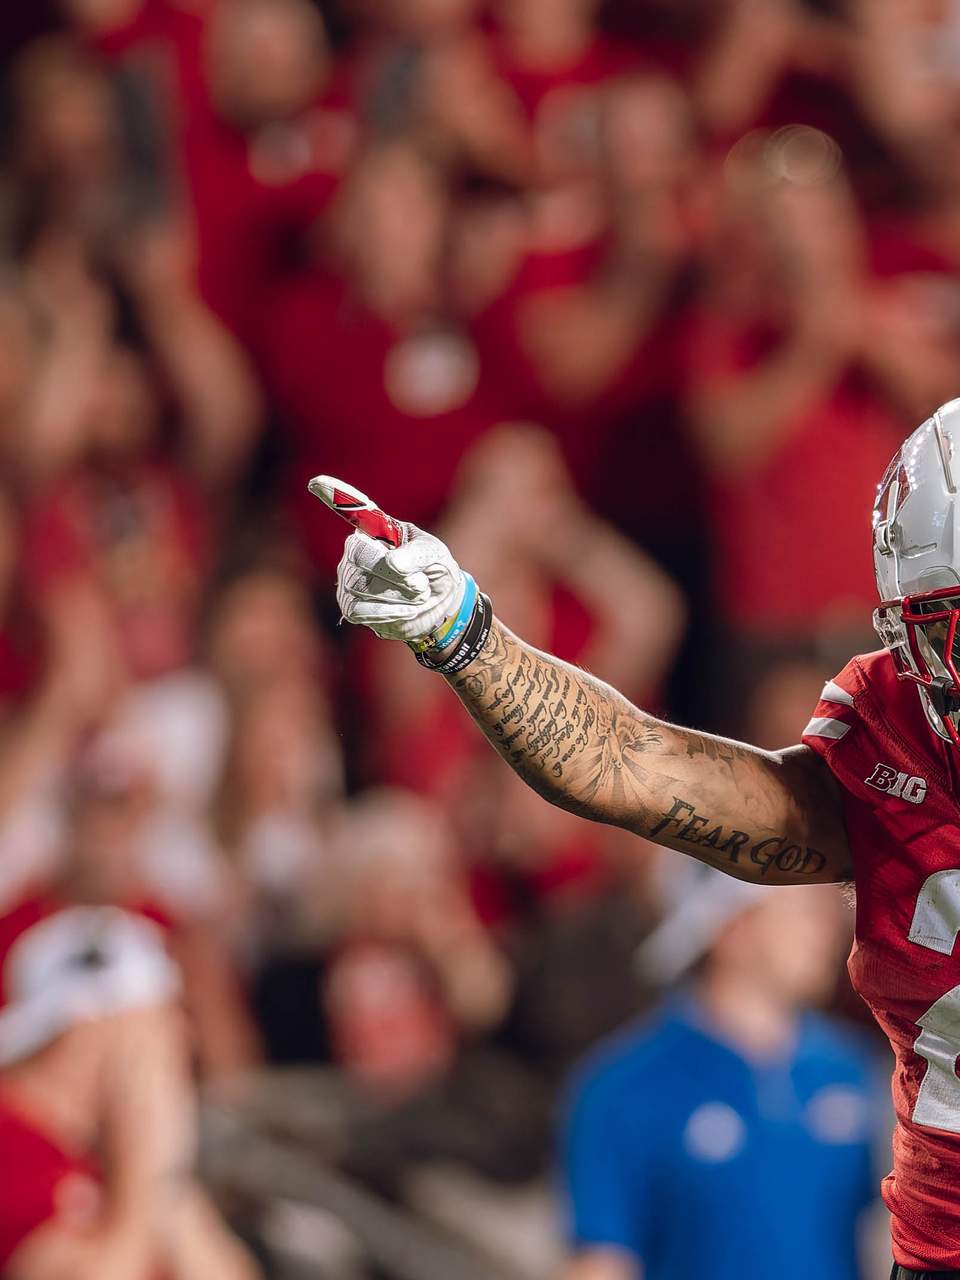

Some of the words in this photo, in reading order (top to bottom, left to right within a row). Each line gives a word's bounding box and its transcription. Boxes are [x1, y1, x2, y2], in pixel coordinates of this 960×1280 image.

[476, 628, 488, 650] PLAN
[650, 796, 749, 864] FEAR
[750, 836, 827, 875] GOD
